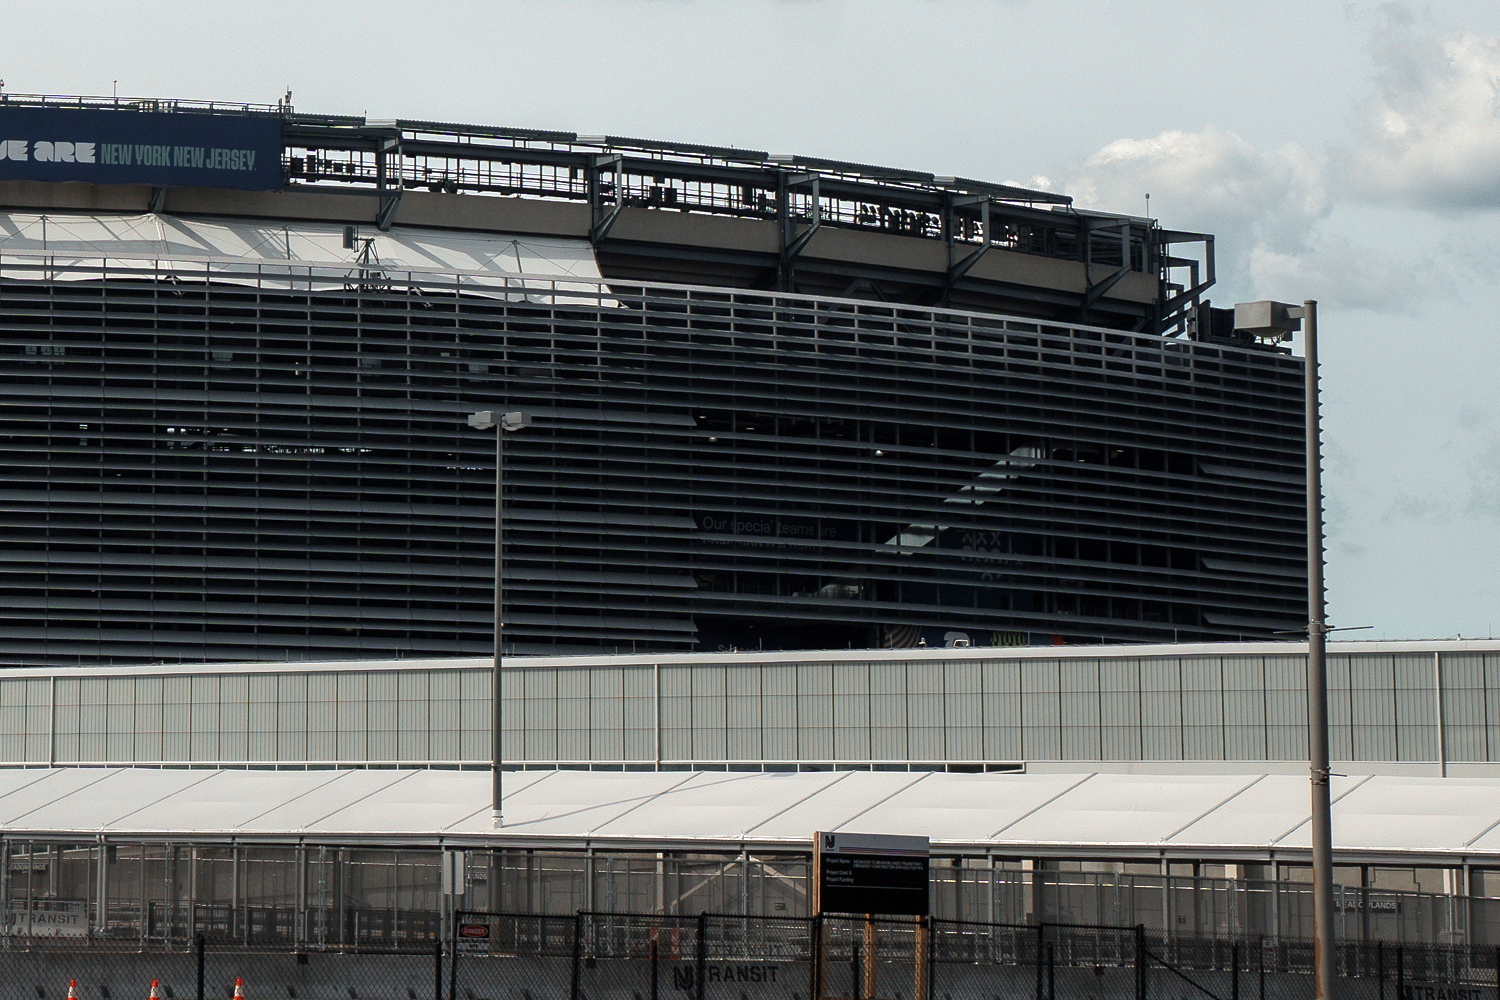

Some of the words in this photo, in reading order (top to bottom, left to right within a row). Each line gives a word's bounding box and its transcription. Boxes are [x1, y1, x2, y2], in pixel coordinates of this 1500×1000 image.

[100, 143, 133, 165] NEW
[134, 144, 171, 166] YORK
[173, 146, 205, 168] NEW
[702, 516, 728, 530] Our
[825, 835, 836, 849] NJ
[462, 927, 486, 935] DANGER
